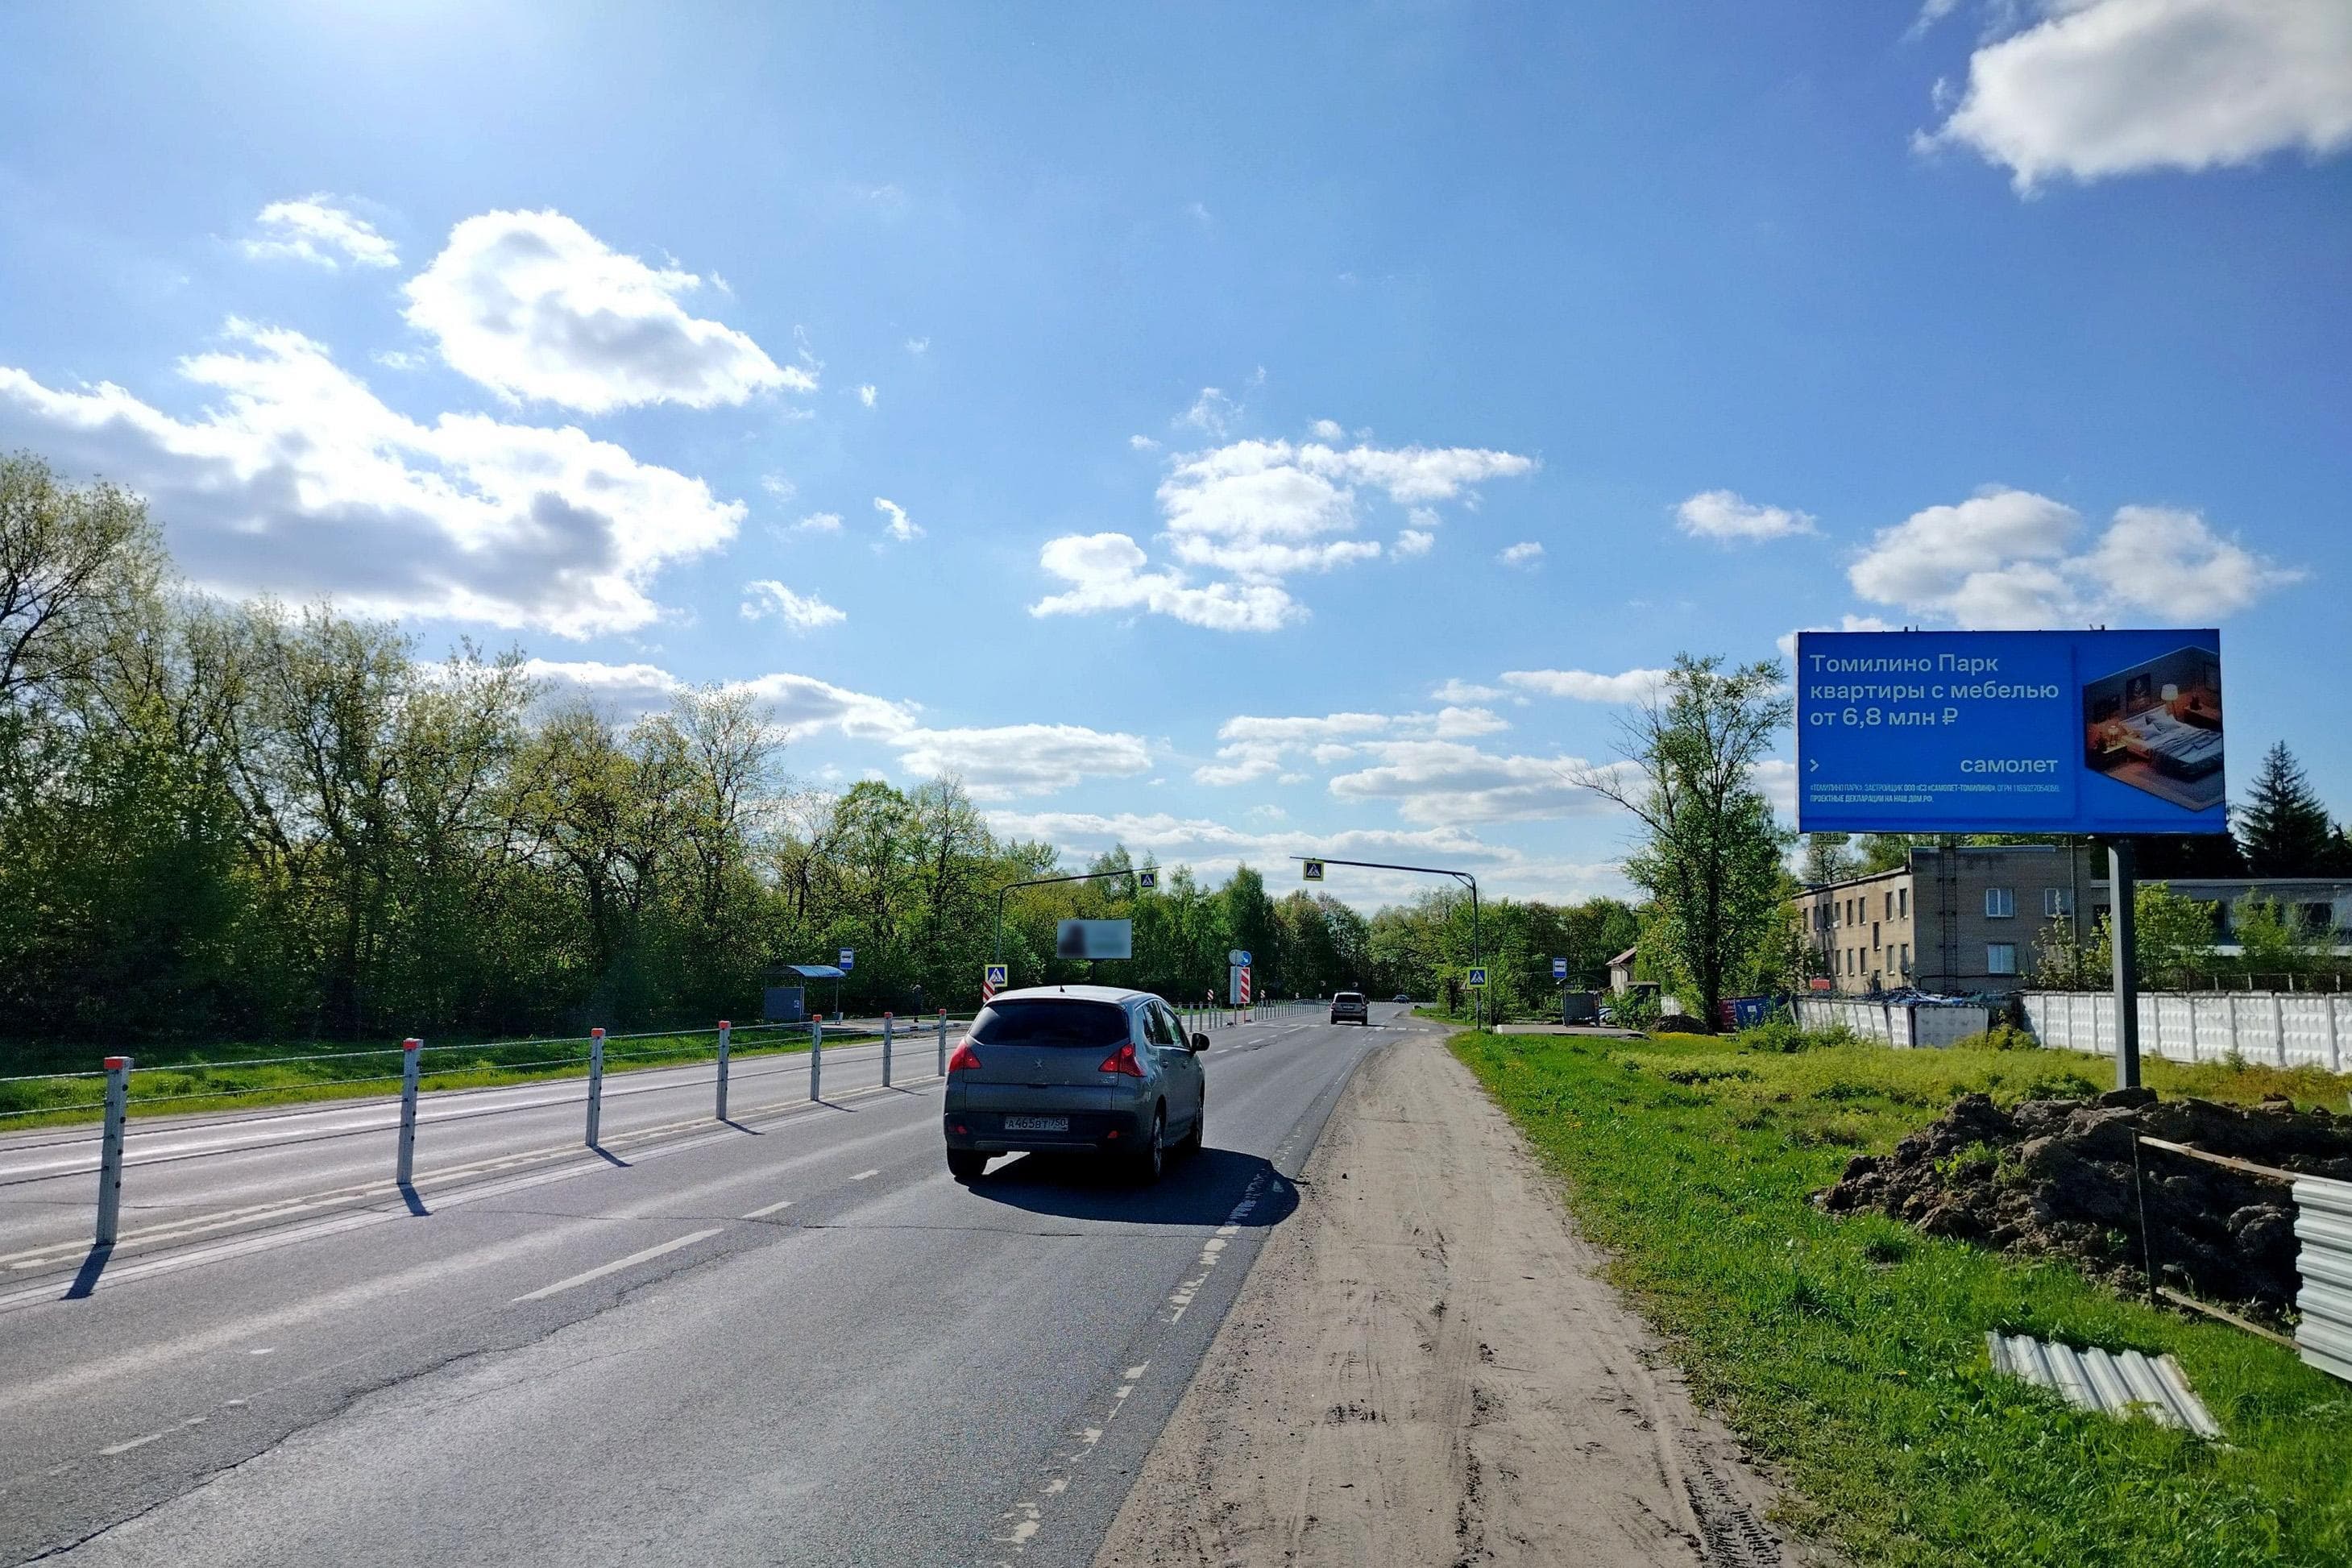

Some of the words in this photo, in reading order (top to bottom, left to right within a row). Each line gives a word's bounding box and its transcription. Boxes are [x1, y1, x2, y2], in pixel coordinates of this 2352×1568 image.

[1810, 653, 1932, 673] Томилино
[1938, 653, 1999, 676] Парк
[1810, 684, 1925, 703] квартиры
[1931, 685, 1944, 699] с
[1950, 680, 2060, 699] мебелью
[1810, 711, 1837, 726] от
[1842, 707, 1882, 728] 6,8
[1888, 711, 1935, 725] млн
[1942, 707, 1959, 726] ₽
[1960, 759, 2059, 774] самолет
[1903, 783, 1915, 792] ООО
